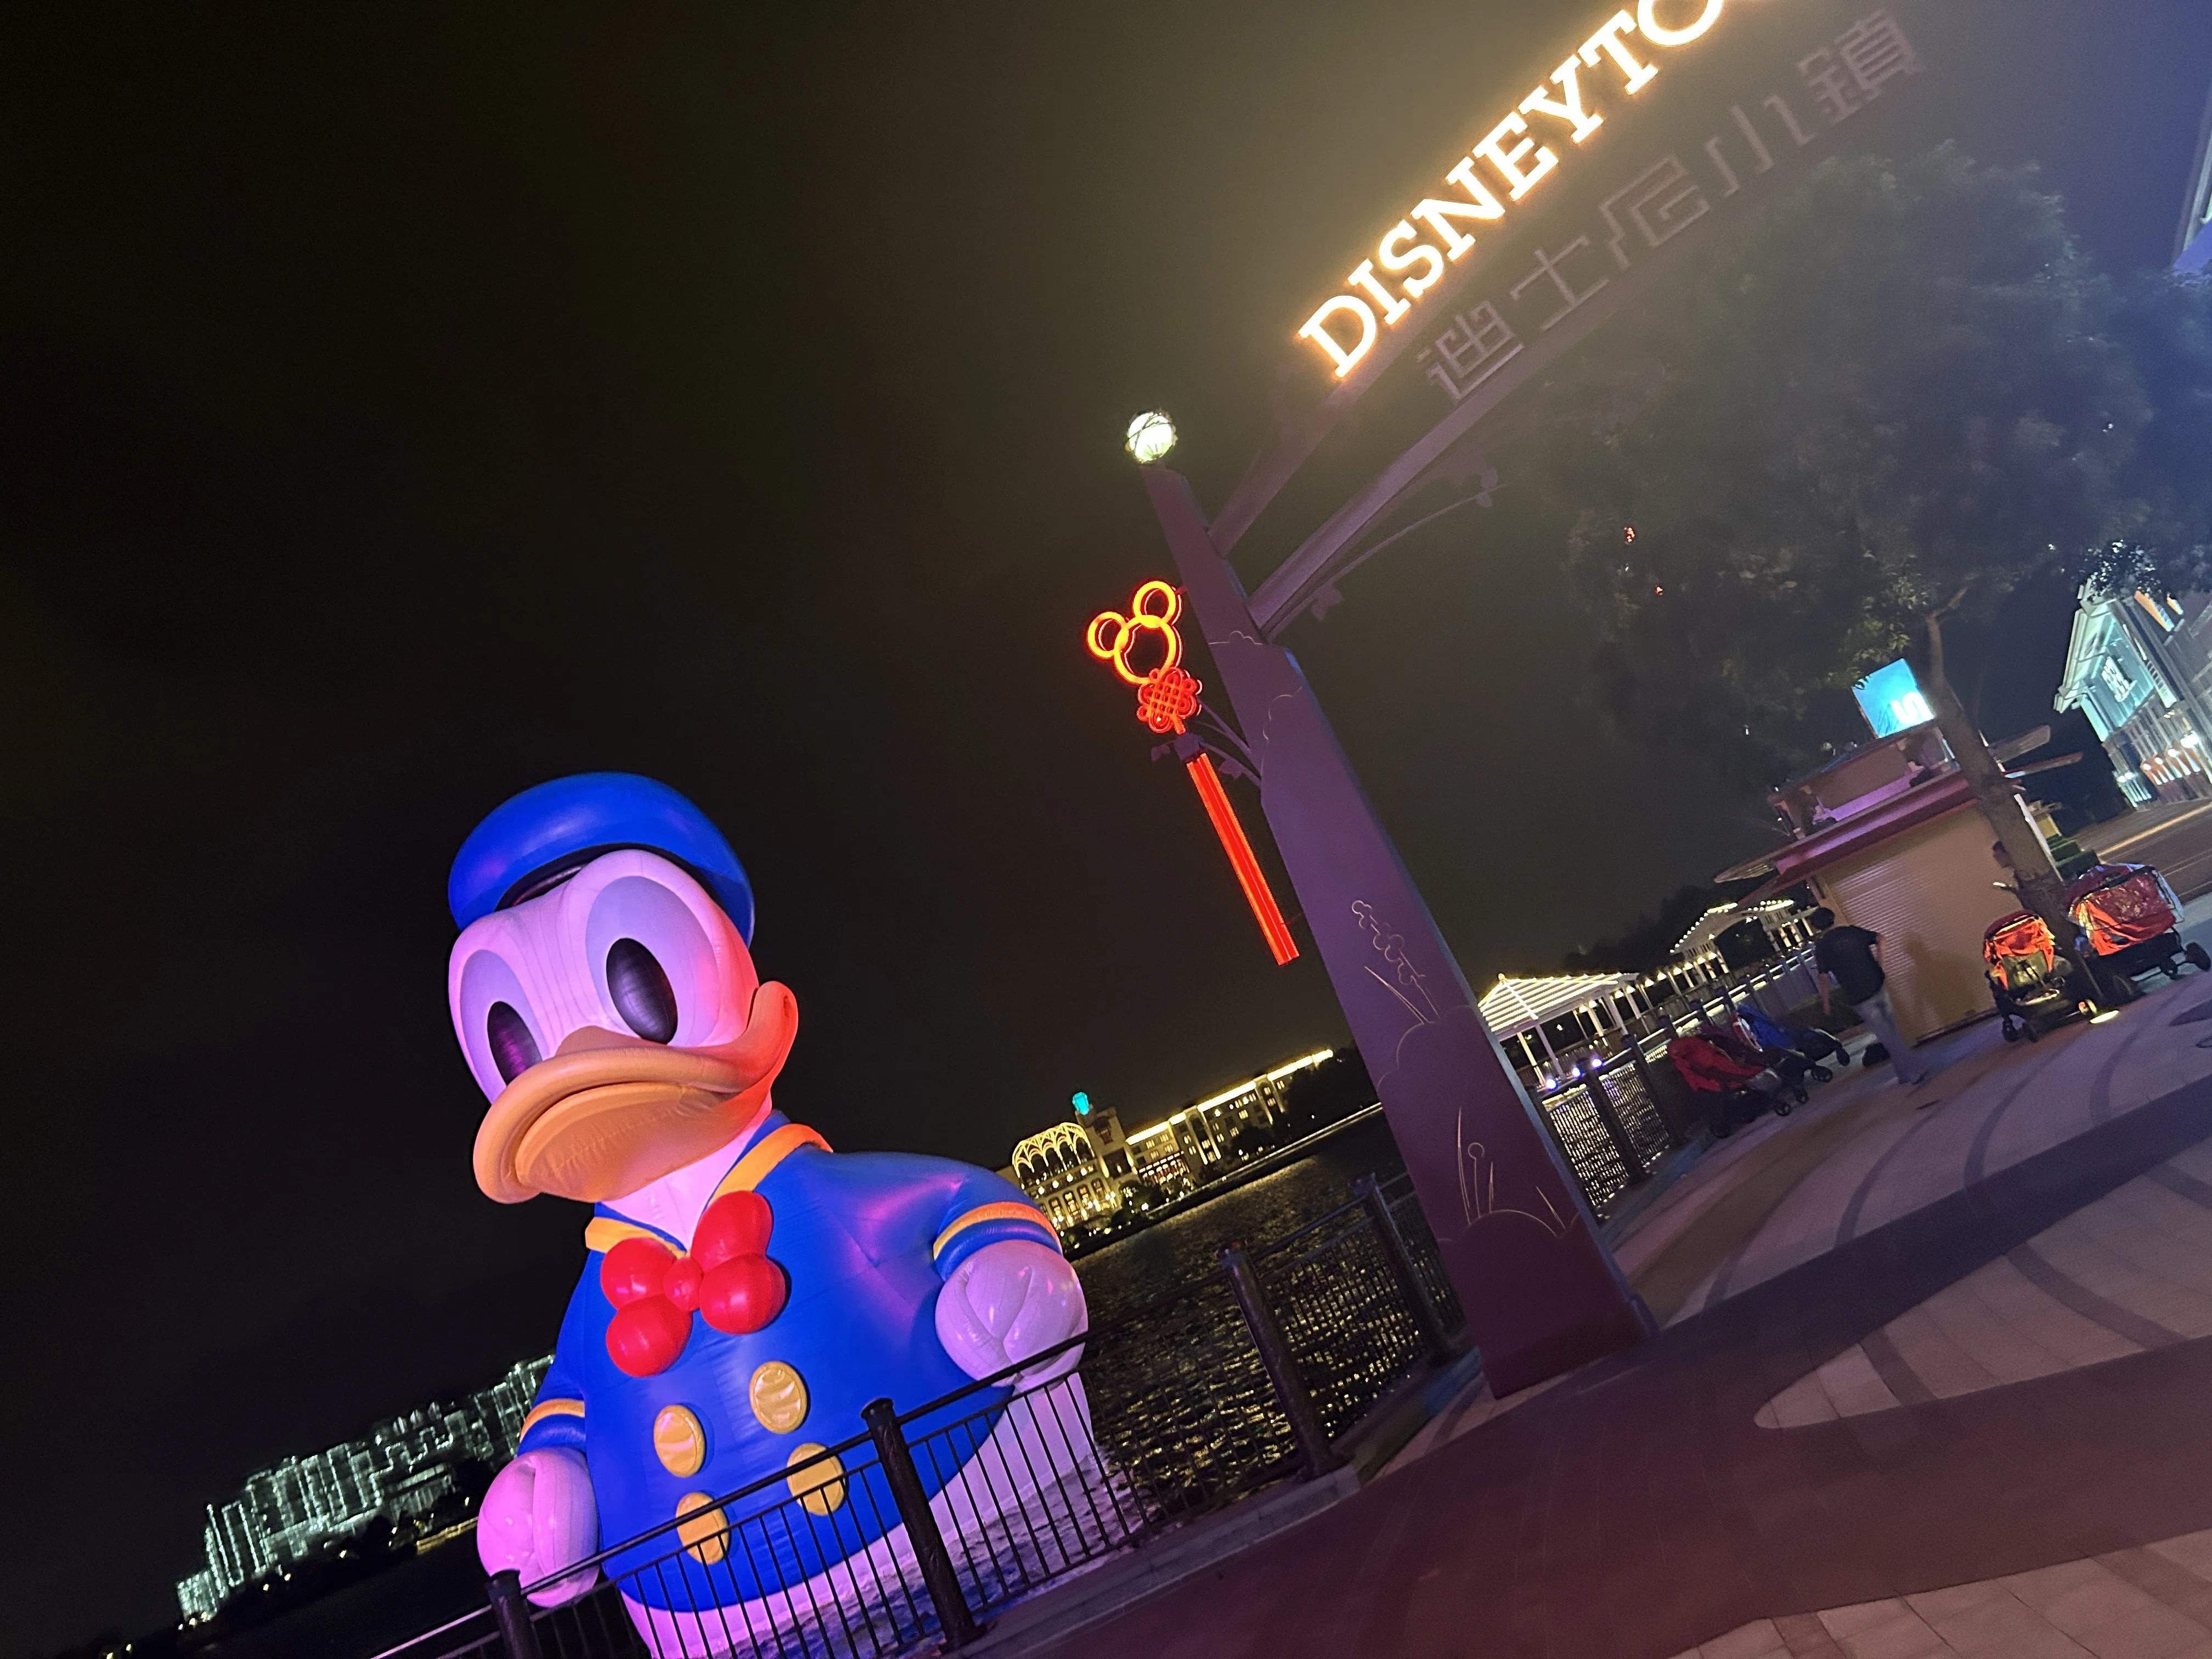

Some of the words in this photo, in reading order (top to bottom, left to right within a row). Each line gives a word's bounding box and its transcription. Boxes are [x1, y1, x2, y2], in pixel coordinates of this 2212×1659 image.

[1416, 8, 1921, 400] 迪士尼小鎮
